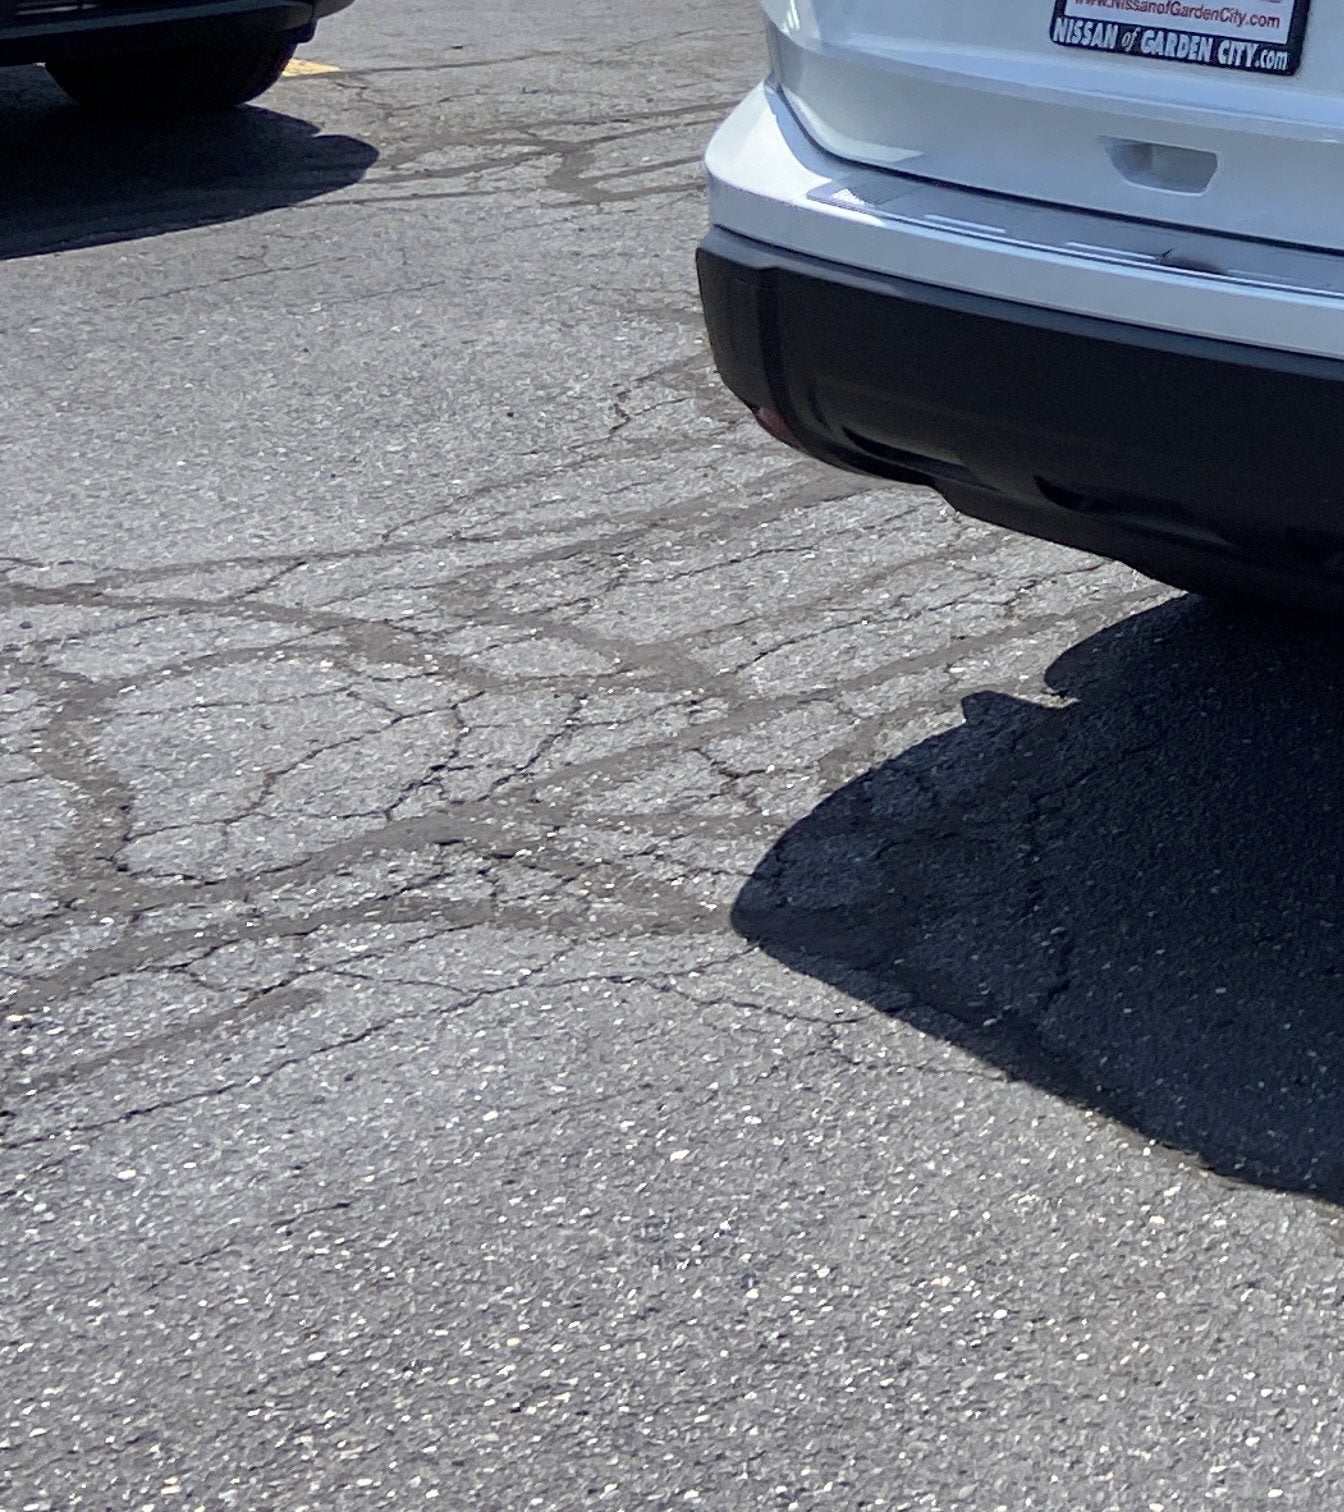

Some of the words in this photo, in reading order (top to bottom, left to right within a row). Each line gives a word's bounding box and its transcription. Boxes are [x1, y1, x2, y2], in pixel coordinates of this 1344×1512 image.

[1052, 17, 1119, 49] NISSAN
[1121, 26, 1138, 51] of
[1140, 29, 1215, 63] GARDEN
[1217, 40, 1288, 71] CITY.com
